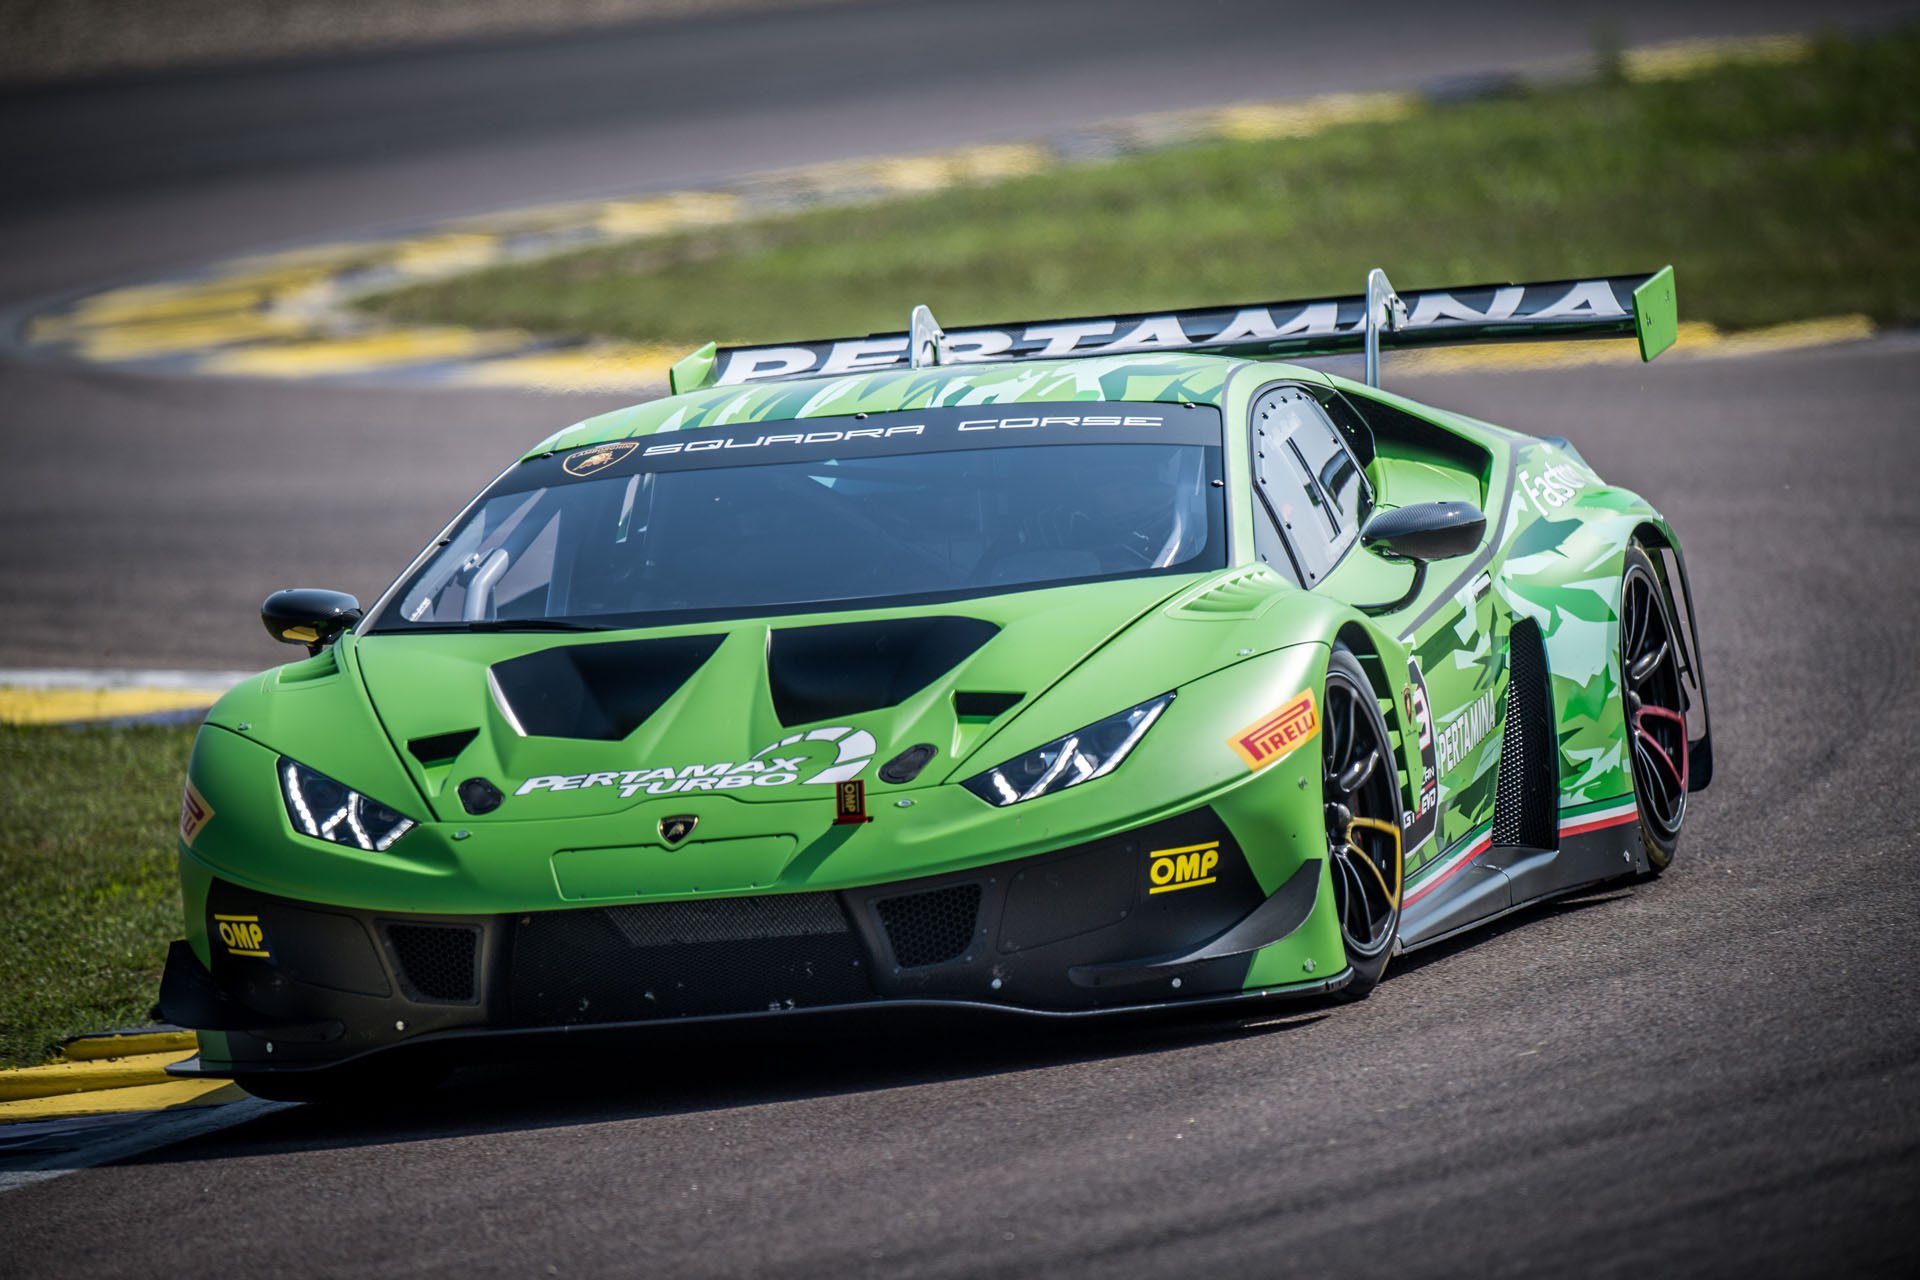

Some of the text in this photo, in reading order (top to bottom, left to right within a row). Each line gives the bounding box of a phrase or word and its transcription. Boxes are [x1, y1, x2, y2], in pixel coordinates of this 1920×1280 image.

[714, 280, 1628, 388] PERTAMNA
[642, 416, 1164, 457] SQUADRA CORSE
[1238, 698, 1316, 762] PIRELLI
[1438, 687, 1496, 780] PERTAMINA
[514, 757, 811, 796] PERTAMAX
[617, 773, 799, 799] TURBO
[1150, 849, 1219, 886] OMP
[219, 921, 264, 950] OMP
